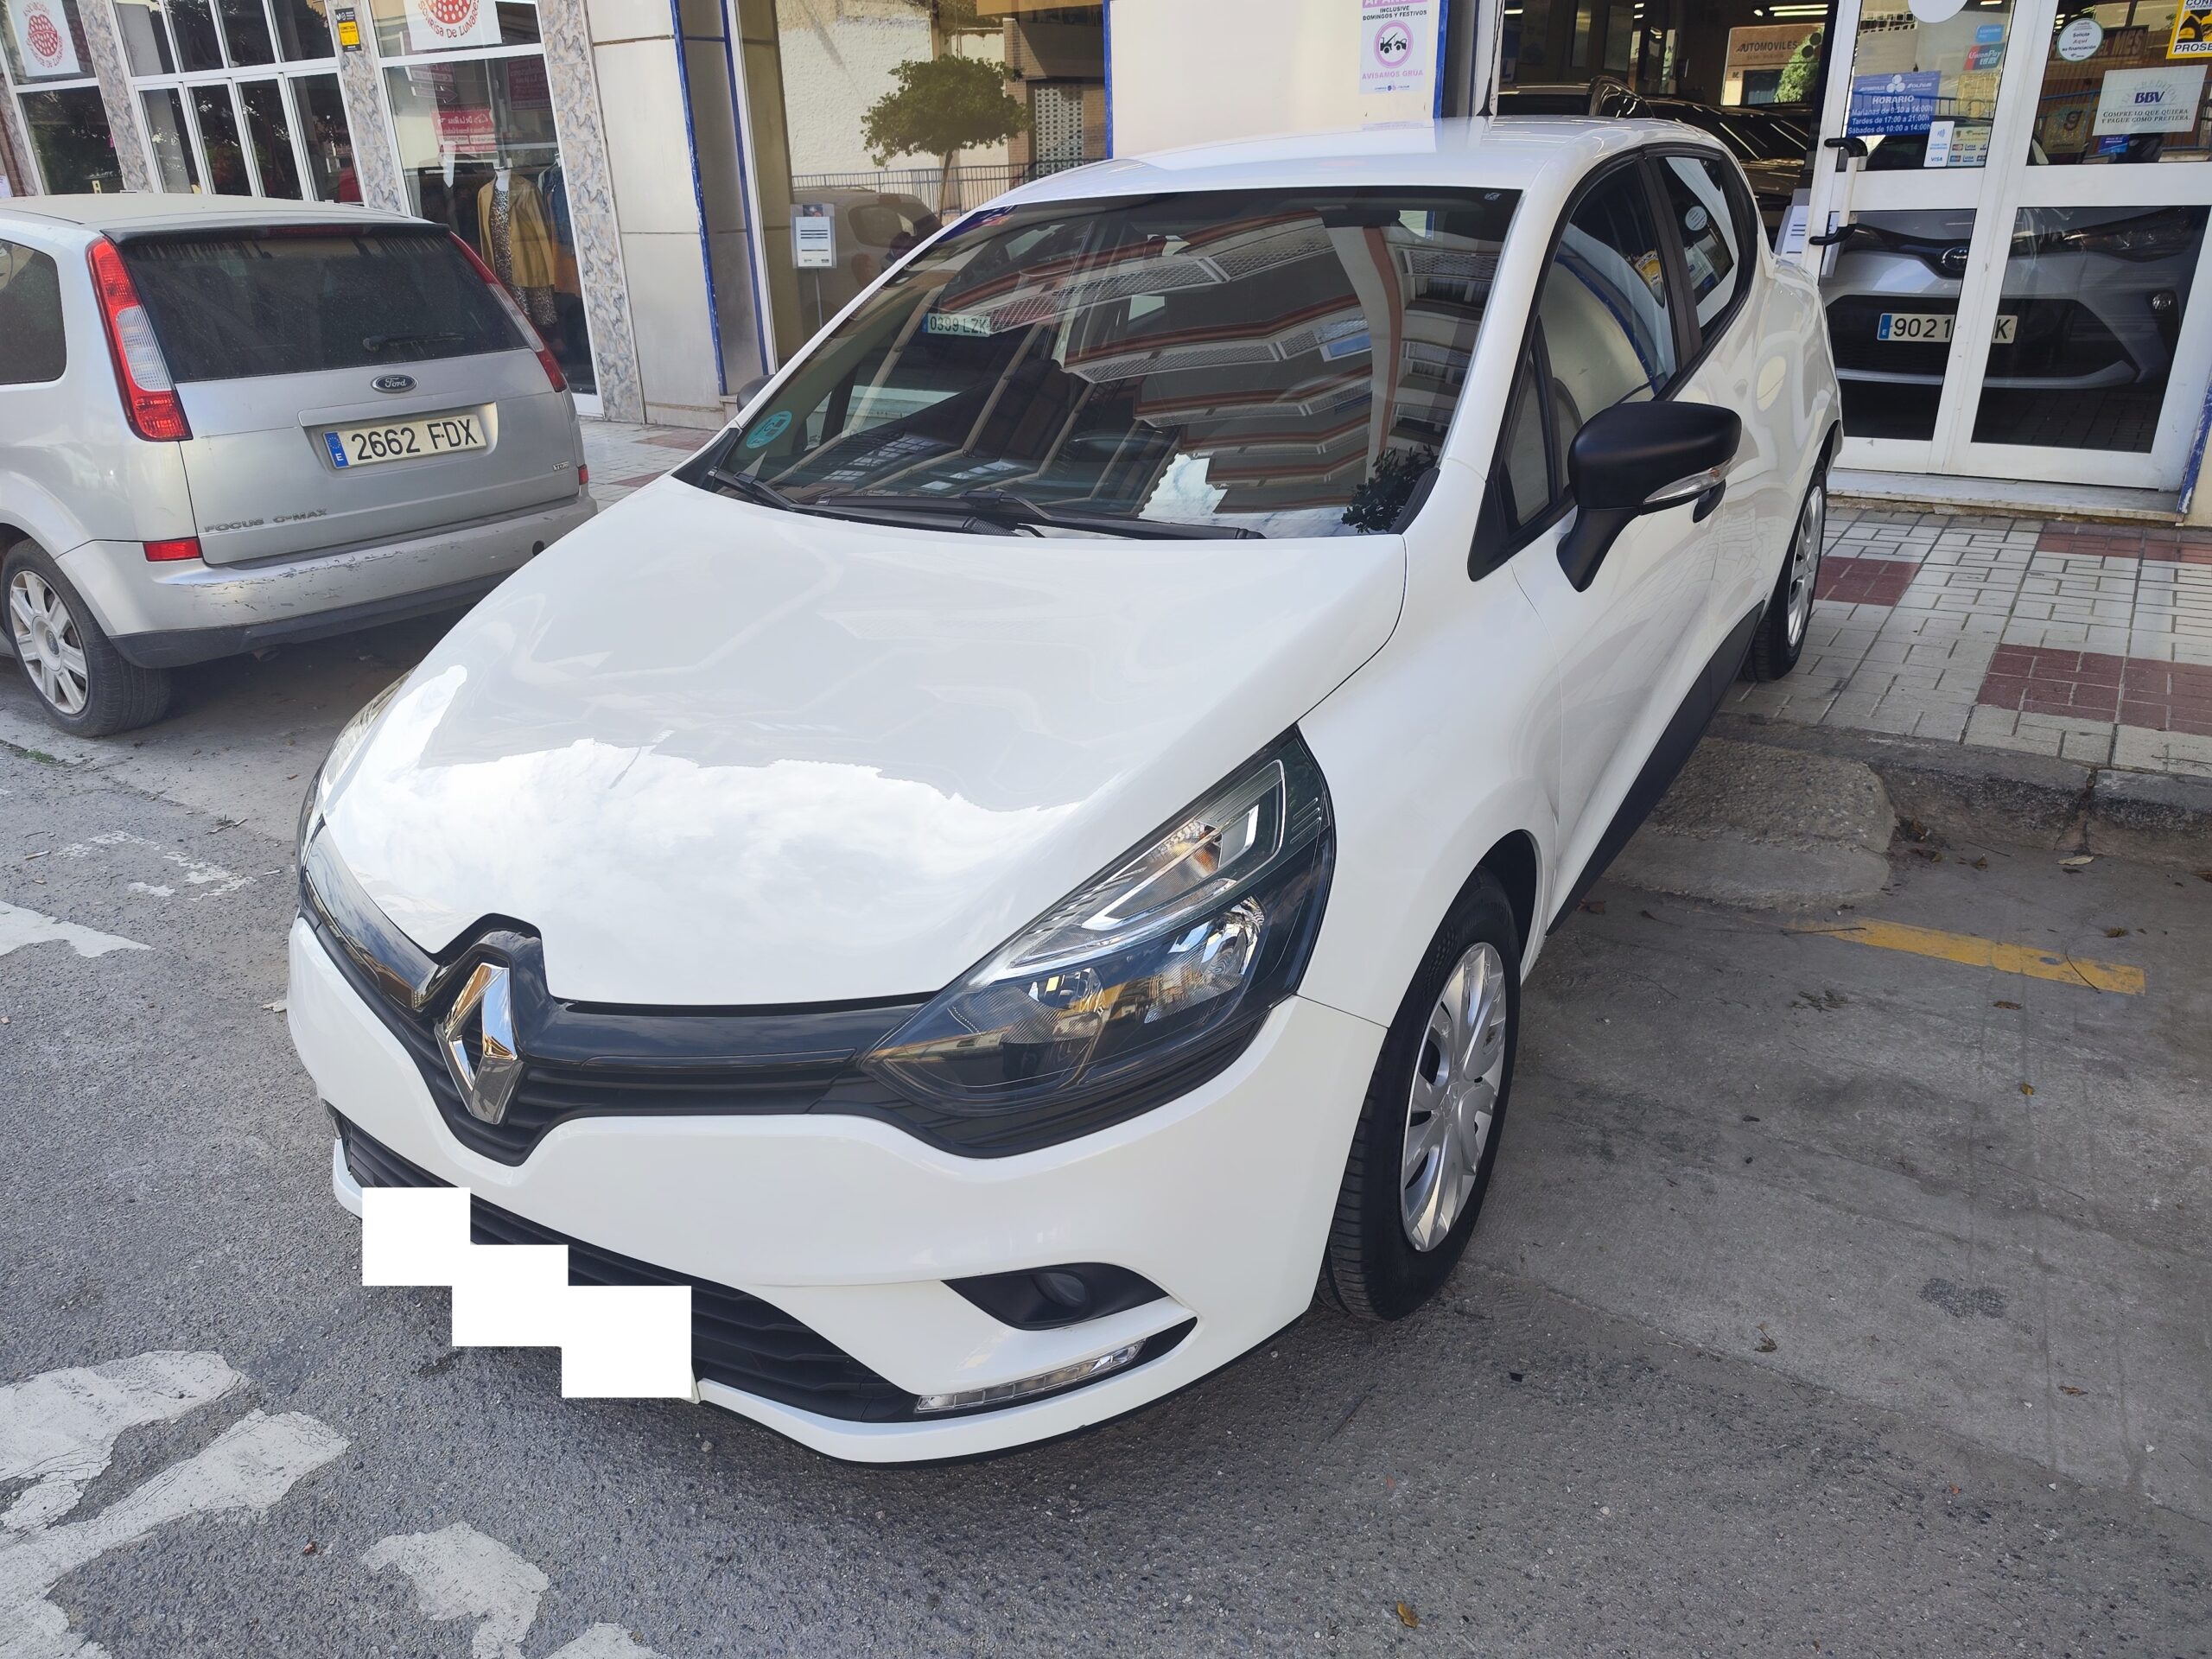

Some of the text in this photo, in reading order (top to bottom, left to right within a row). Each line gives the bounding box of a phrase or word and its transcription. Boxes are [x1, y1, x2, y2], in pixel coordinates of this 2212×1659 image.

[446, 29, 457, 39] De
[459, 0, 480, 36] LUNaRe
[1736, 41, 1797, 53] AUTOMOVILES
[1969, 49, 2002, 59] UnionPay
[1362, 71, 1400, 79] AVISAMOS
[1872, 95, 1915, 105] HORARIO
[2134, 91, 2165, 104] BBV
[1908, 113, 1930, 122] 21:00h
[1847, 125, 1875, 134] Sábados
[1910, 123, 1931, 131] 14:00h
[963, 318, 988, 334] LZK
[1893, 317, 1951, 339] 9021
[385, 376, 407, 389] Ford
[335, 418, 478, 462] E 2662 FDX
[204, 508, 327, 533] FOCUS C-MAX
